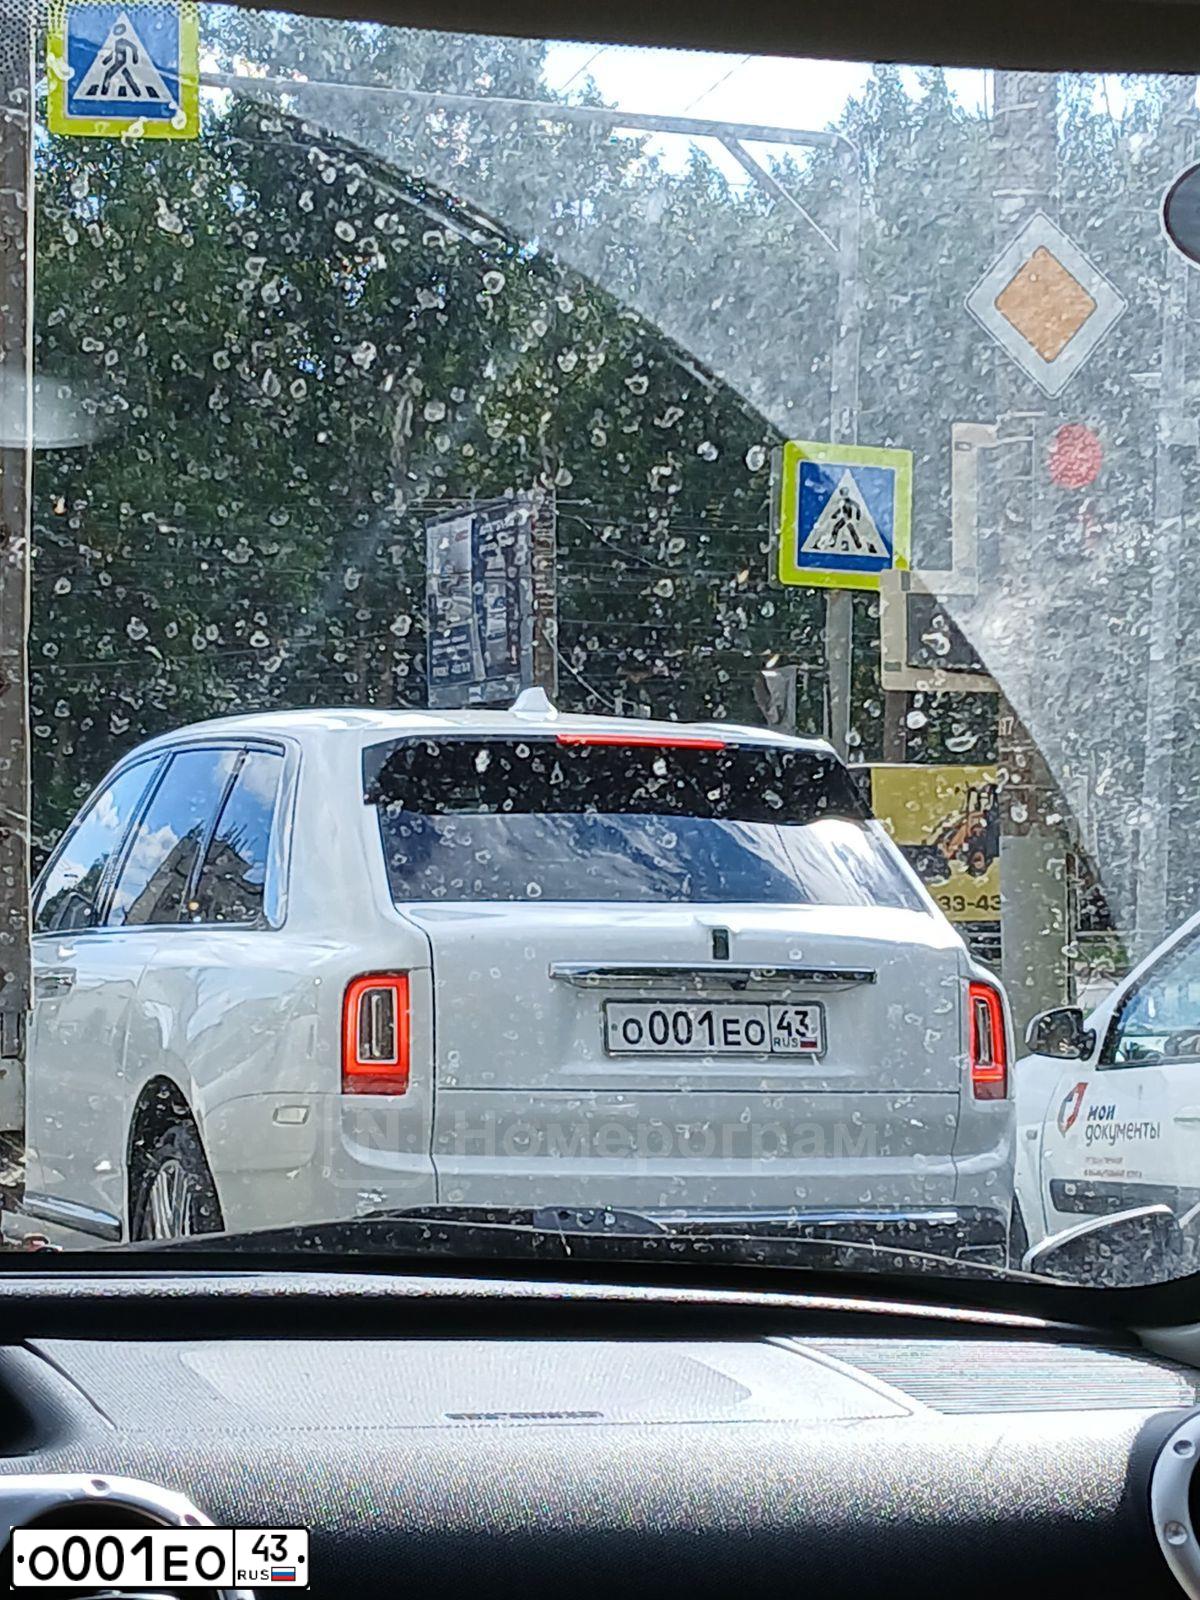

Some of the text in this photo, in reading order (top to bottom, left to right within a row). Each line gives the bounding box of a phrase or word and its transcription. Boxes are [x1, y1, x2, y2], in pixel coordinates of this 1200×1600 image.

[623, 1009, 809, 1046] О001ЕО 43
[773, 1036, 799, 1048] RUS
[1085, 1121, 1161, 1147] документы
